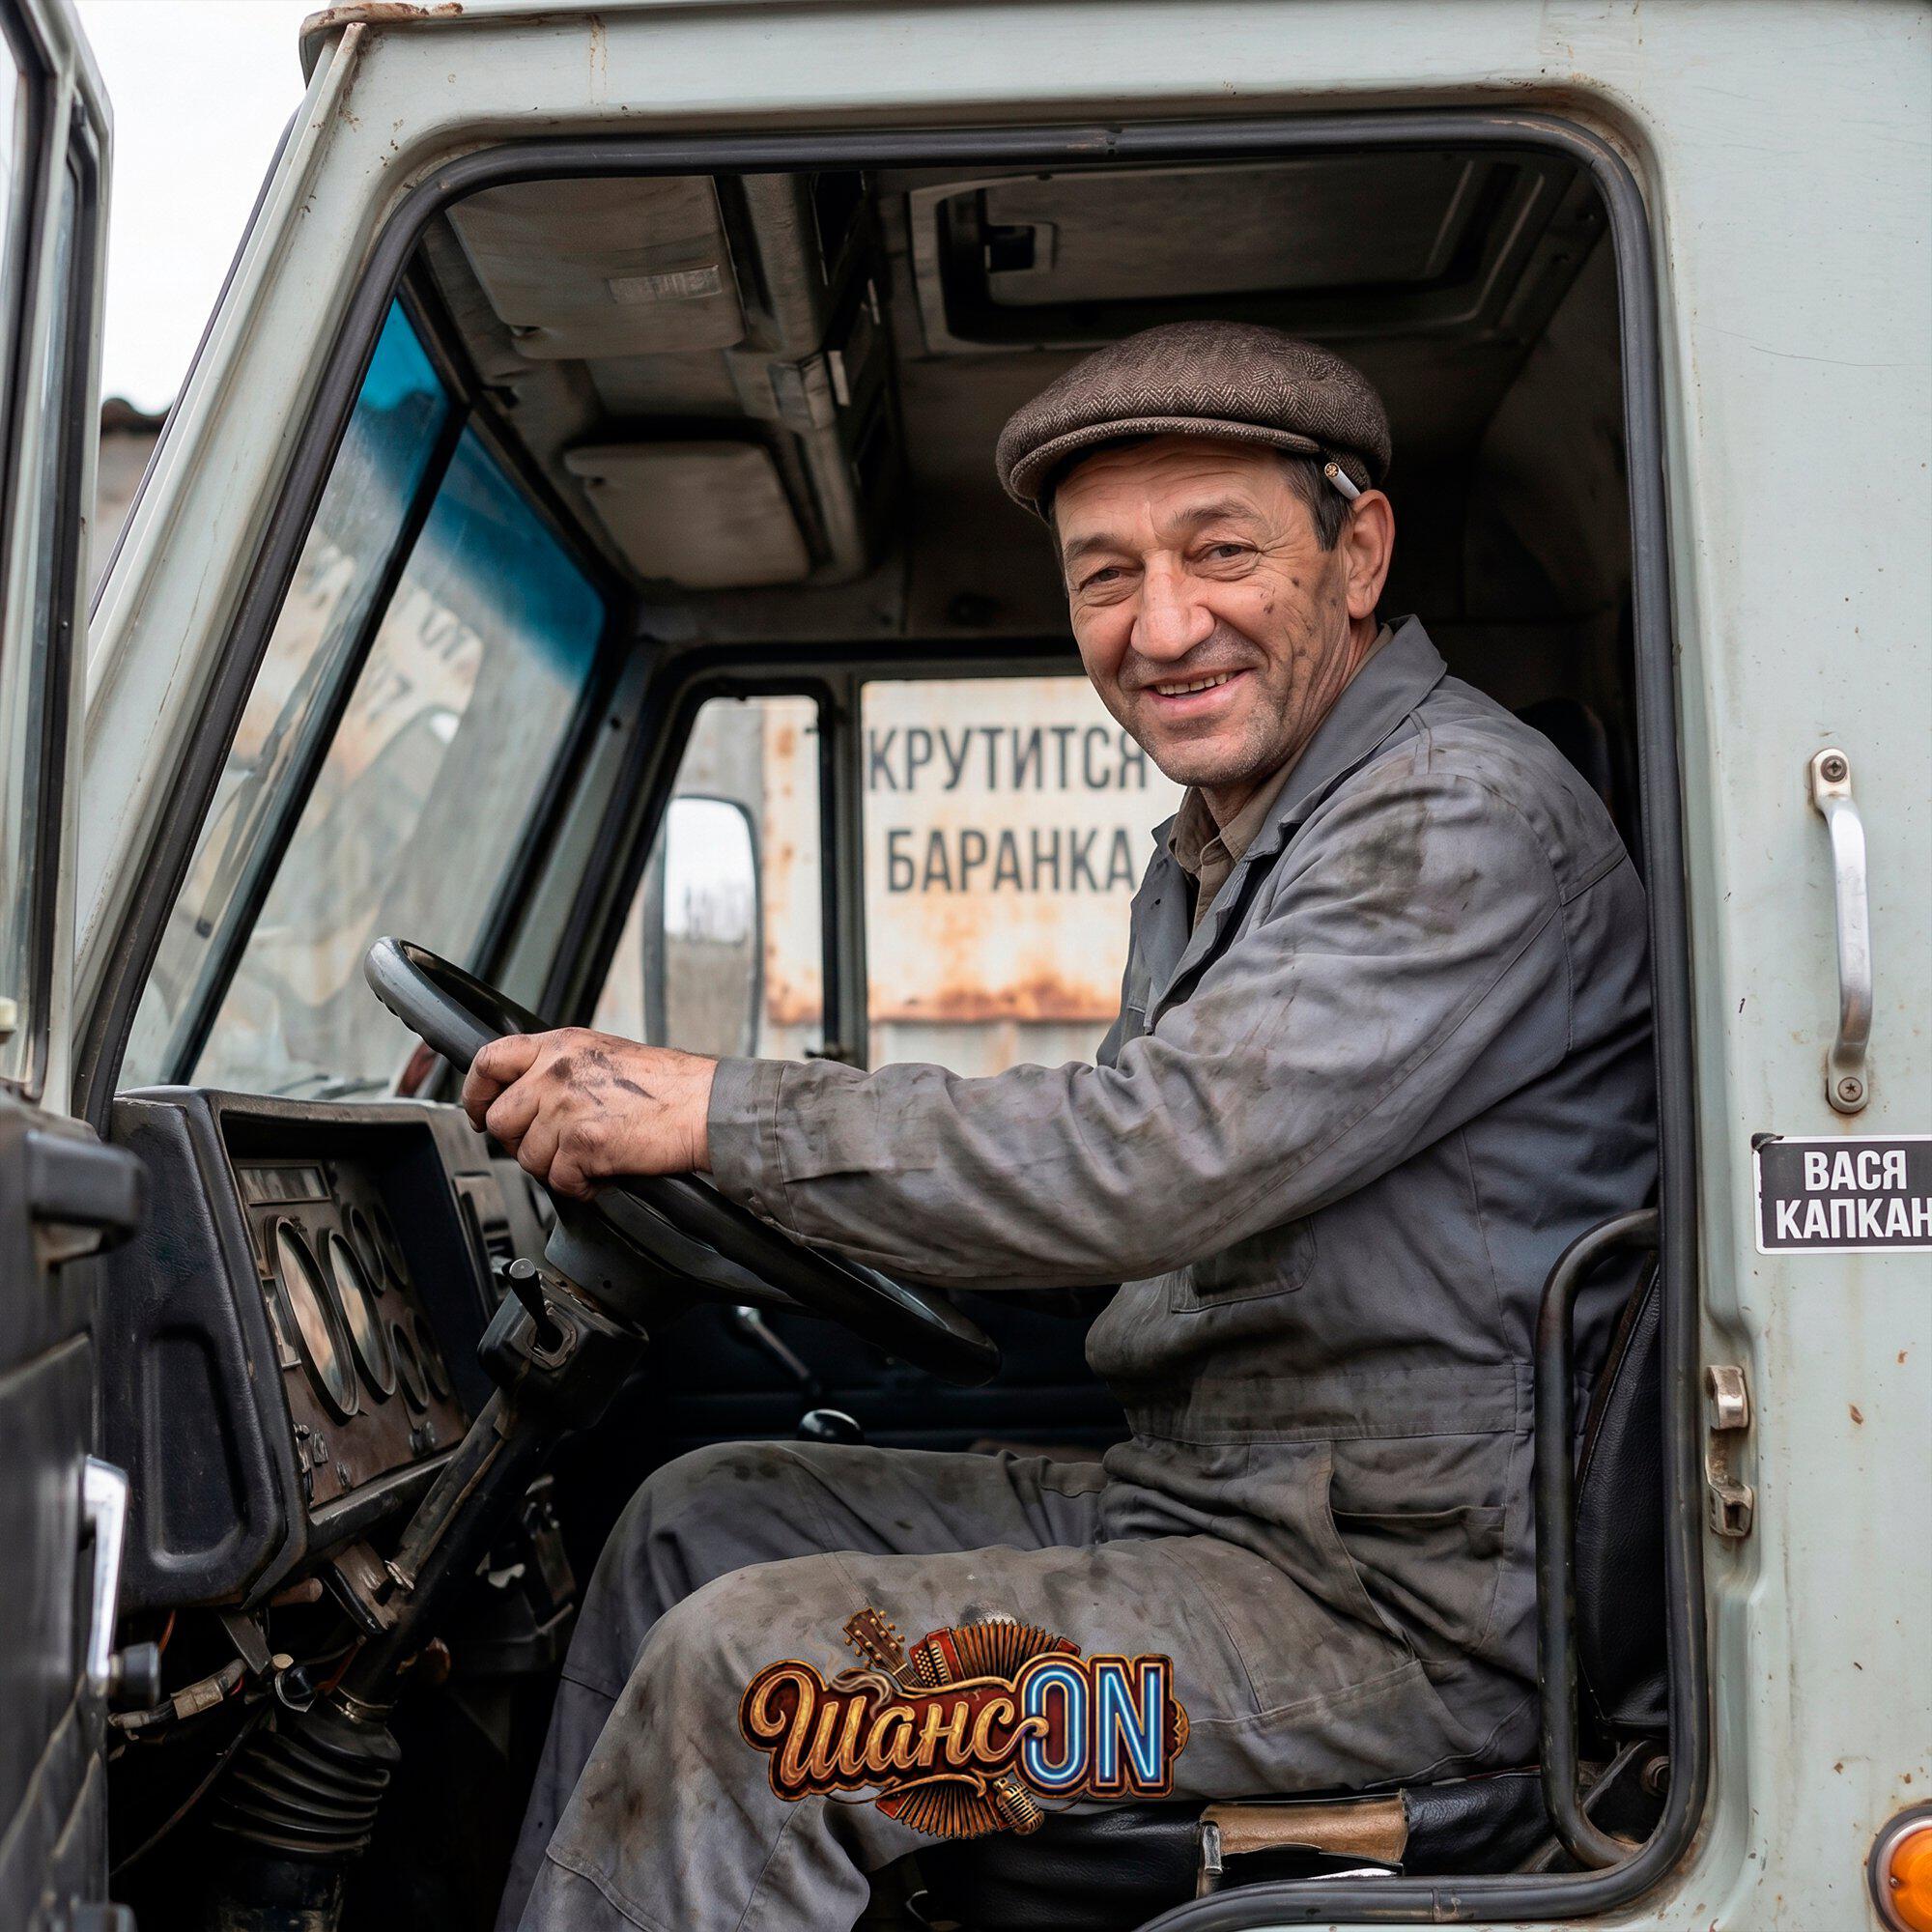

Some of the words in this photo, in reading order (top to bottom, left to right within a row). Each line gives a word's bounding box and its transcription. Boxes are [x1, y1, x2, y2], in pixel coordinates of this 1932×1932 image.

[869, 726, 1147, 791] КРУТИТСЯ
[887, 828, 1135, 893] БАРАНКА
[1804, 1150, 1907, 1191] ВАСЯ
[1776, 1197, 1932, 1239] КАПКАН
